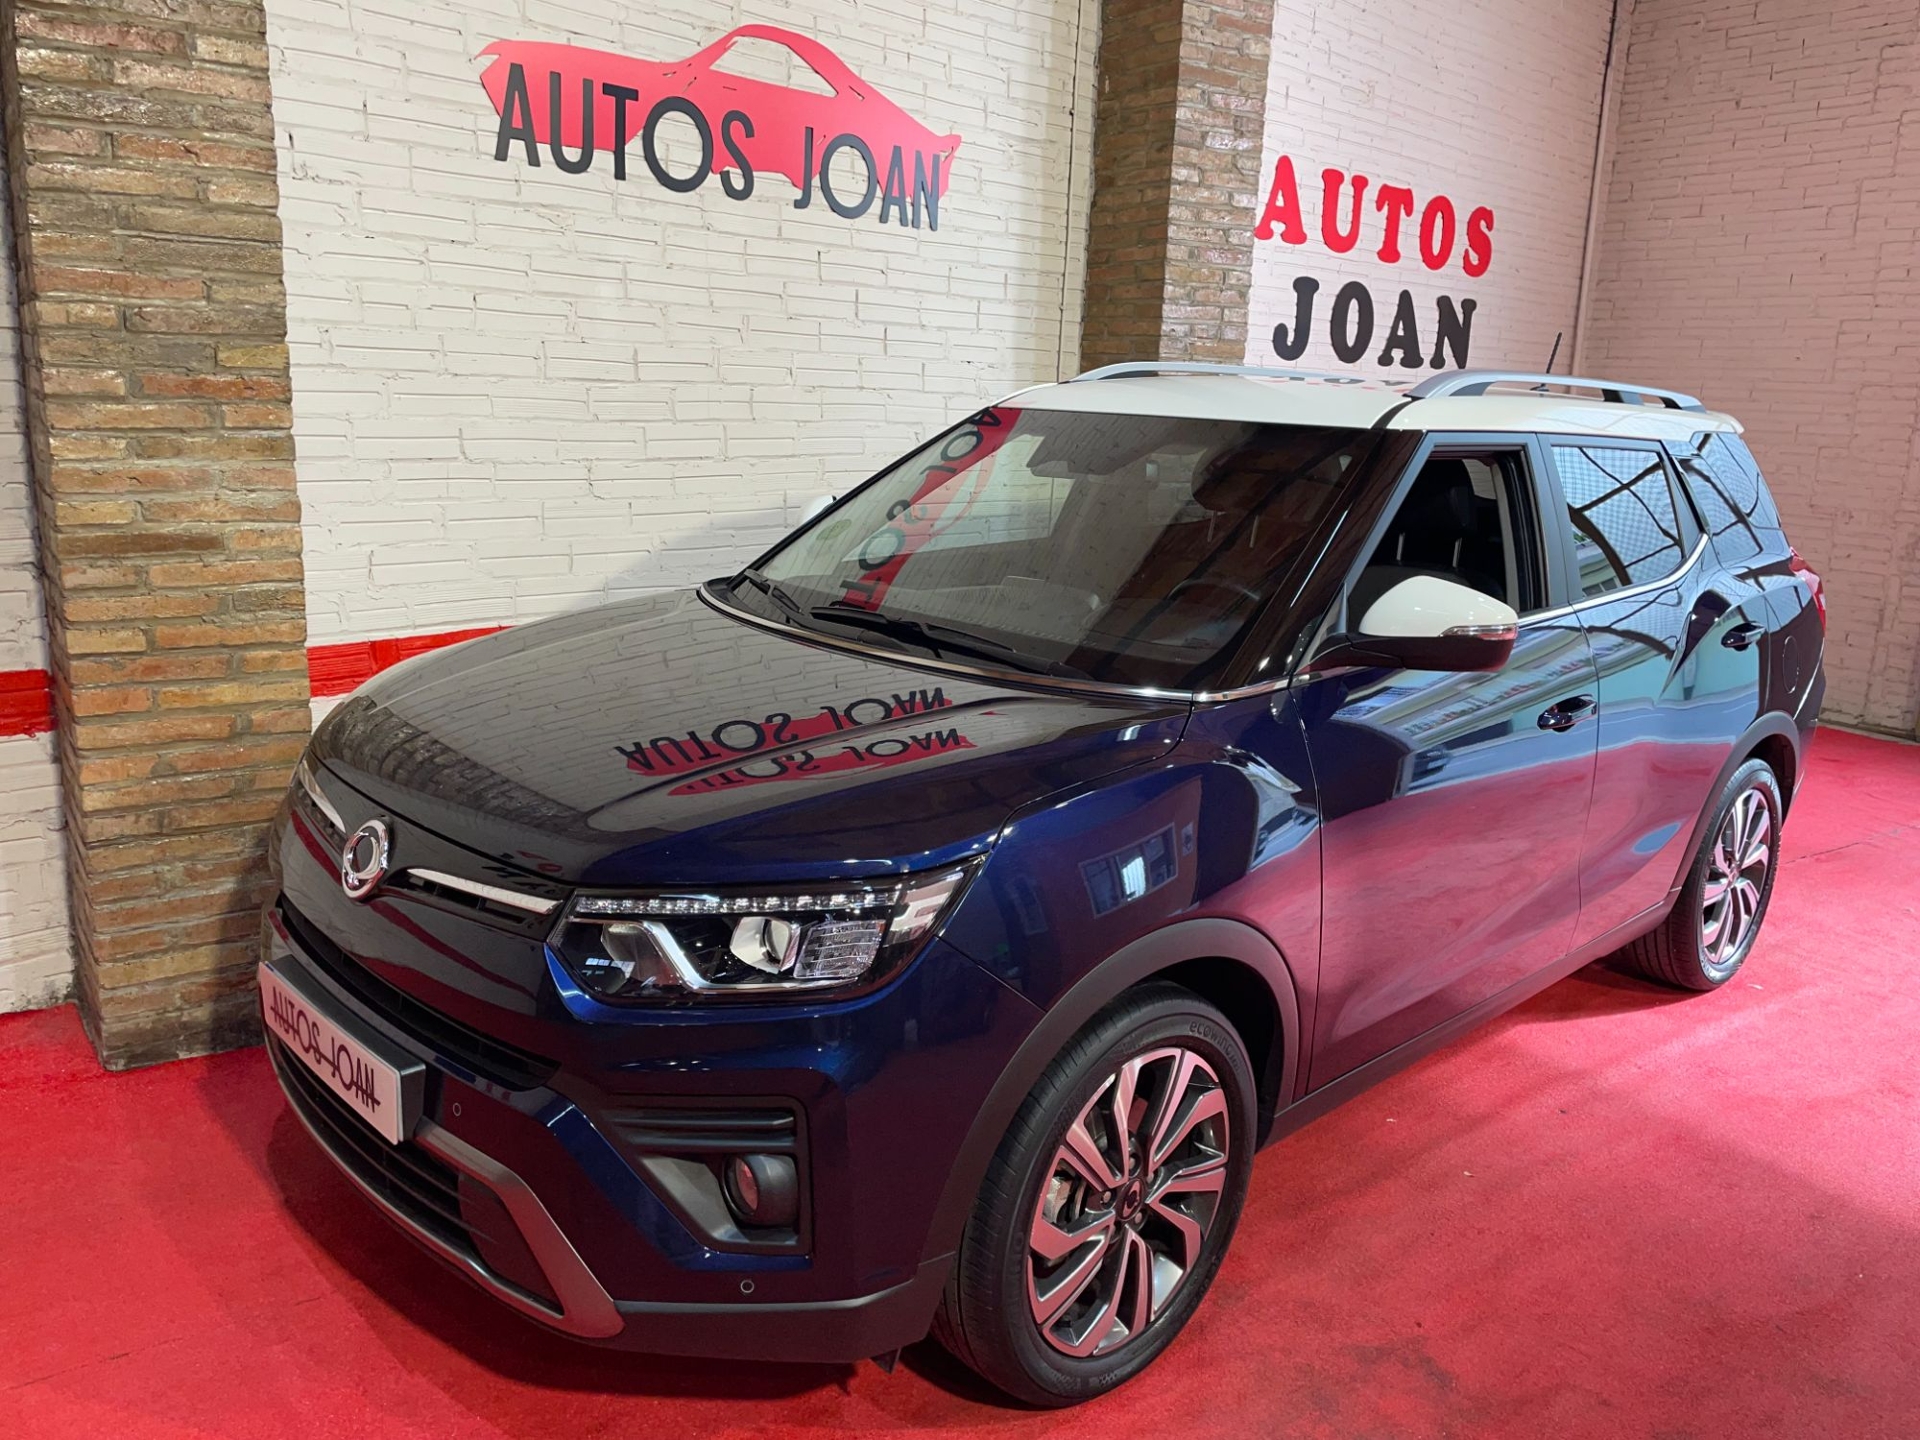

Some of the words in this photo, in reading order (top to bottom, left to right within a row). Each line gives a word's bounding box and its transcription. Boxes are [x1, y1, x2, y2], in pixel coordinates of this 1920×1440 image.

[494, 63, 755, 200] AUTOS
[793, 126, 941, 231] JOAN
[1253, 154, 1495, 277] AUTOS
[1272, 276, 1477, 369] JOAN
[271, 986, 321, 1065] AUTOS
[331, 1037, 379, 1113] JOAN
